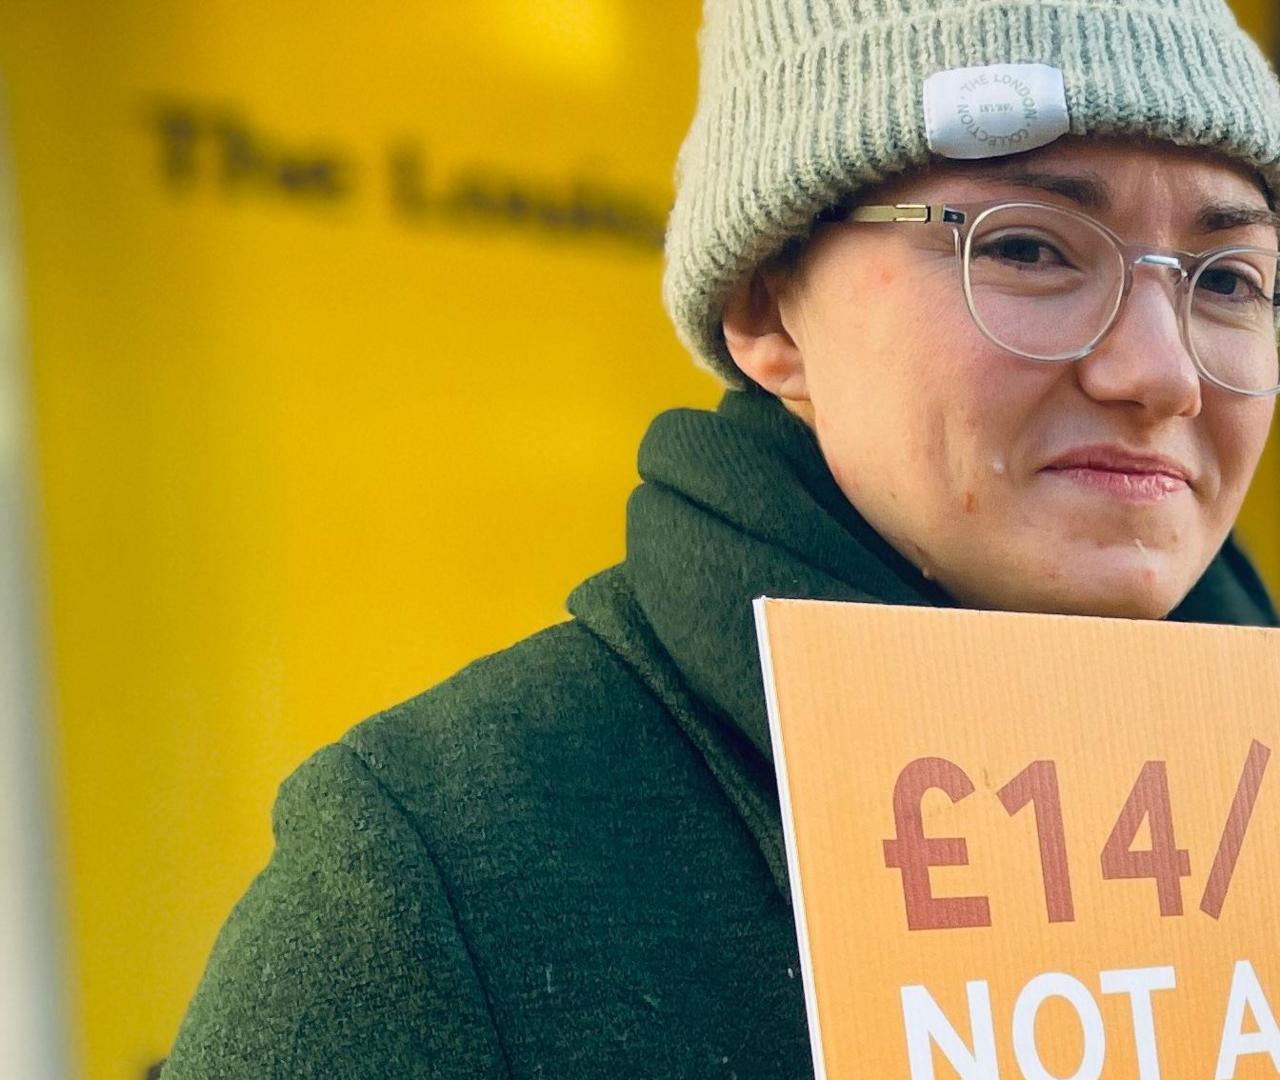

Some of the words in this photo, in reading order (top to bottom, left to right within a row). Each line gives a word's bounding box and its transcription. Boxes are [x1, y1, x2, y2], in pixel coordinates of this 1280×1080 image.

[960, 74, 989, 93] THE
[993, 74, 1037, 120] LONDON
[957, 103, 1030, 147] COLLECTION
